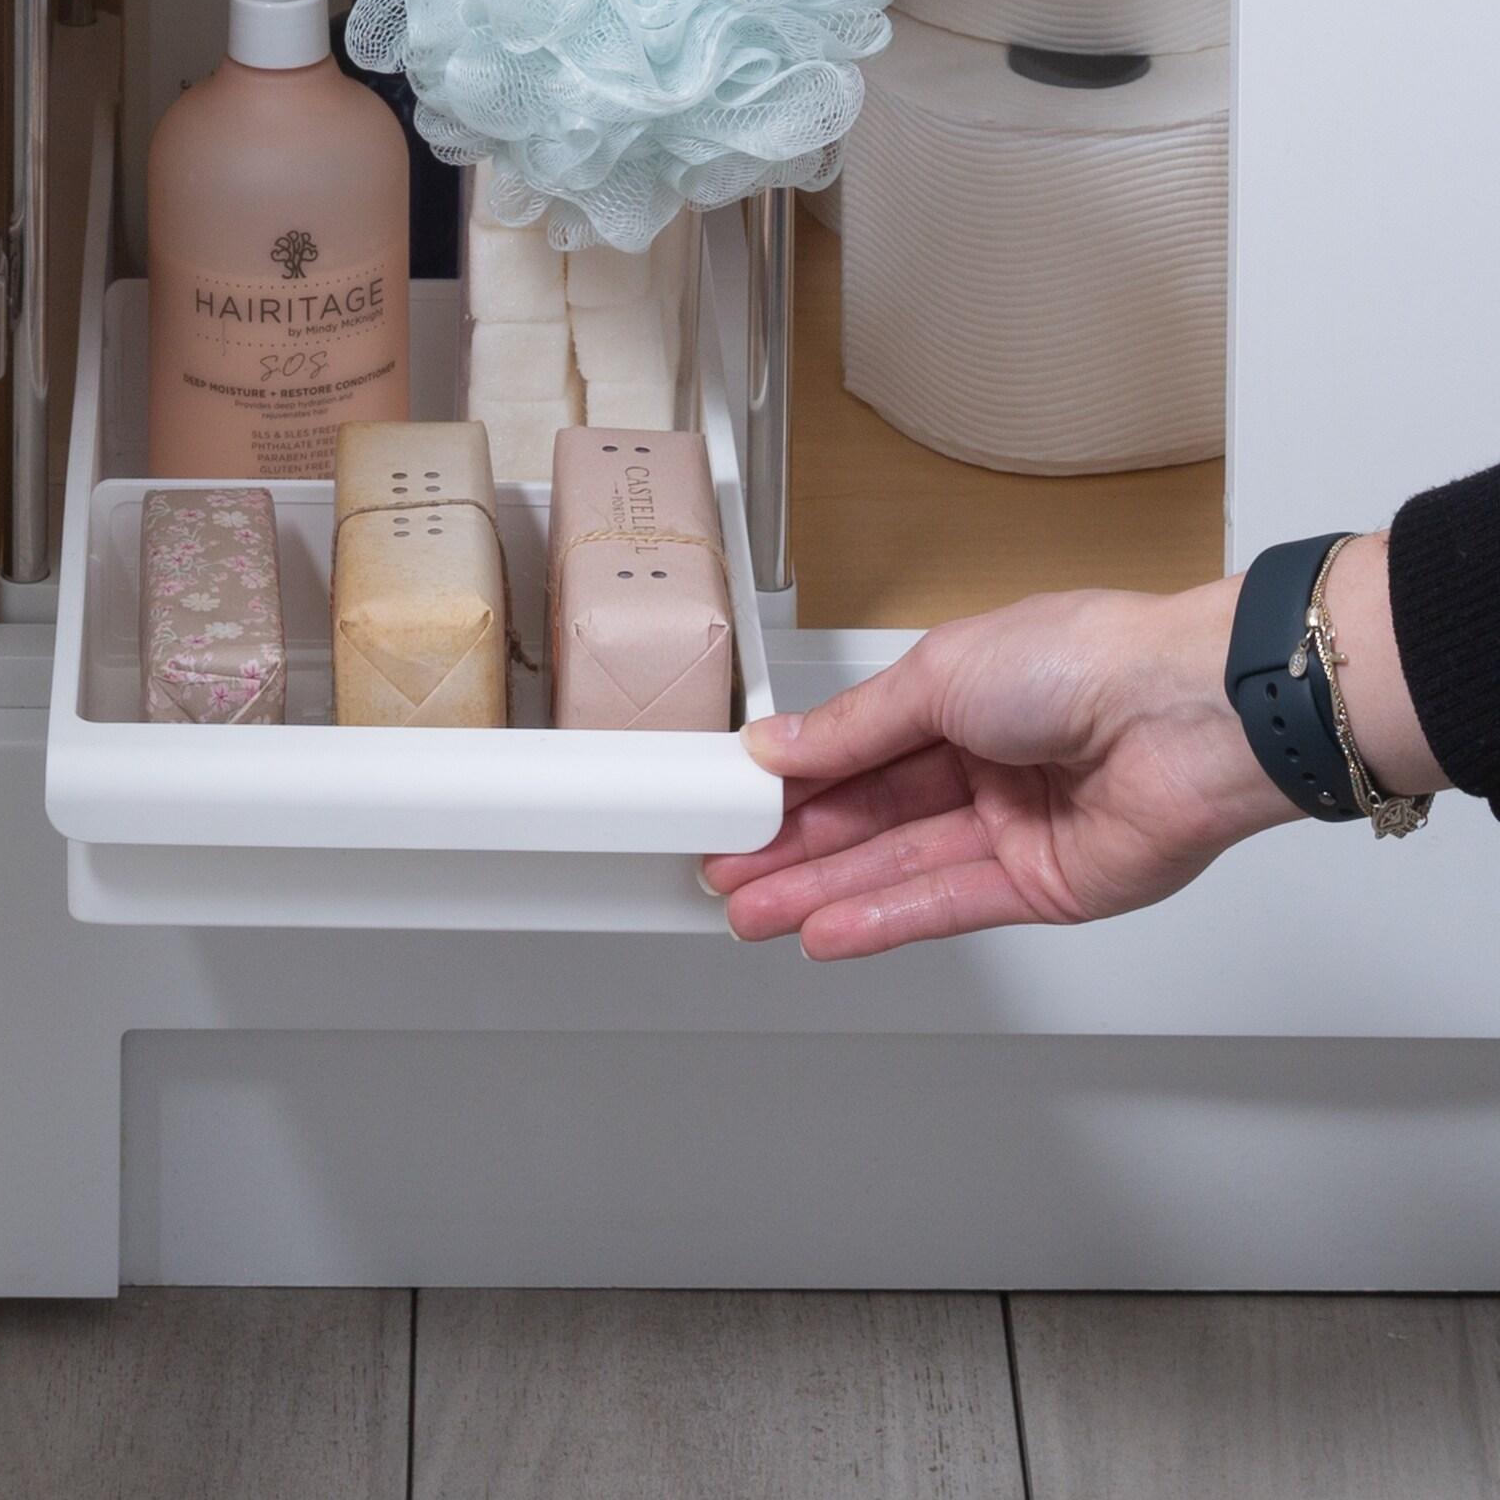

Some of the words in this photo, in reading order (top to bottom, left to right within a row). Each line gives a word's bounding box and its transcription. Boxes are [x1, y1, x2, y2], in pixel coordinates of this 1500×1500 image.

[195, 277, 384, 324] HAIRITAGE
[287, 327, 302, 339] by
[306, 322, 339, 335] Mindy
[340, 307, 384, 329] McKnight
[183, 372, 208, 388] DEEP
[209, 382, 267, 399] MOISTURE
[280, 383, 333, 399] RESTORE
[334, 360, 397, 392] CONDITIONER
[233, 399, 273, 410] Provides
[274, 400, 296, 411] deep
[297, 395, 338, 409] hydration
[338, 391, 354, 403] and
[261, 409, 312, 420] rejuvenates
[312, 407, 329, 417] hair
[251, 429, 271, 439] SLS
[273, 431, 282, 439] &
[284, 428, 310, 439] SLES
[251, 440, 312, 451] PHTHALATE
[316, 436, 335, 446] FRE
[257, 452, 308, 462] PARABEN
[259, 465, 303, 474] GLUTEN
[305, 460, 332, 472] FREE
